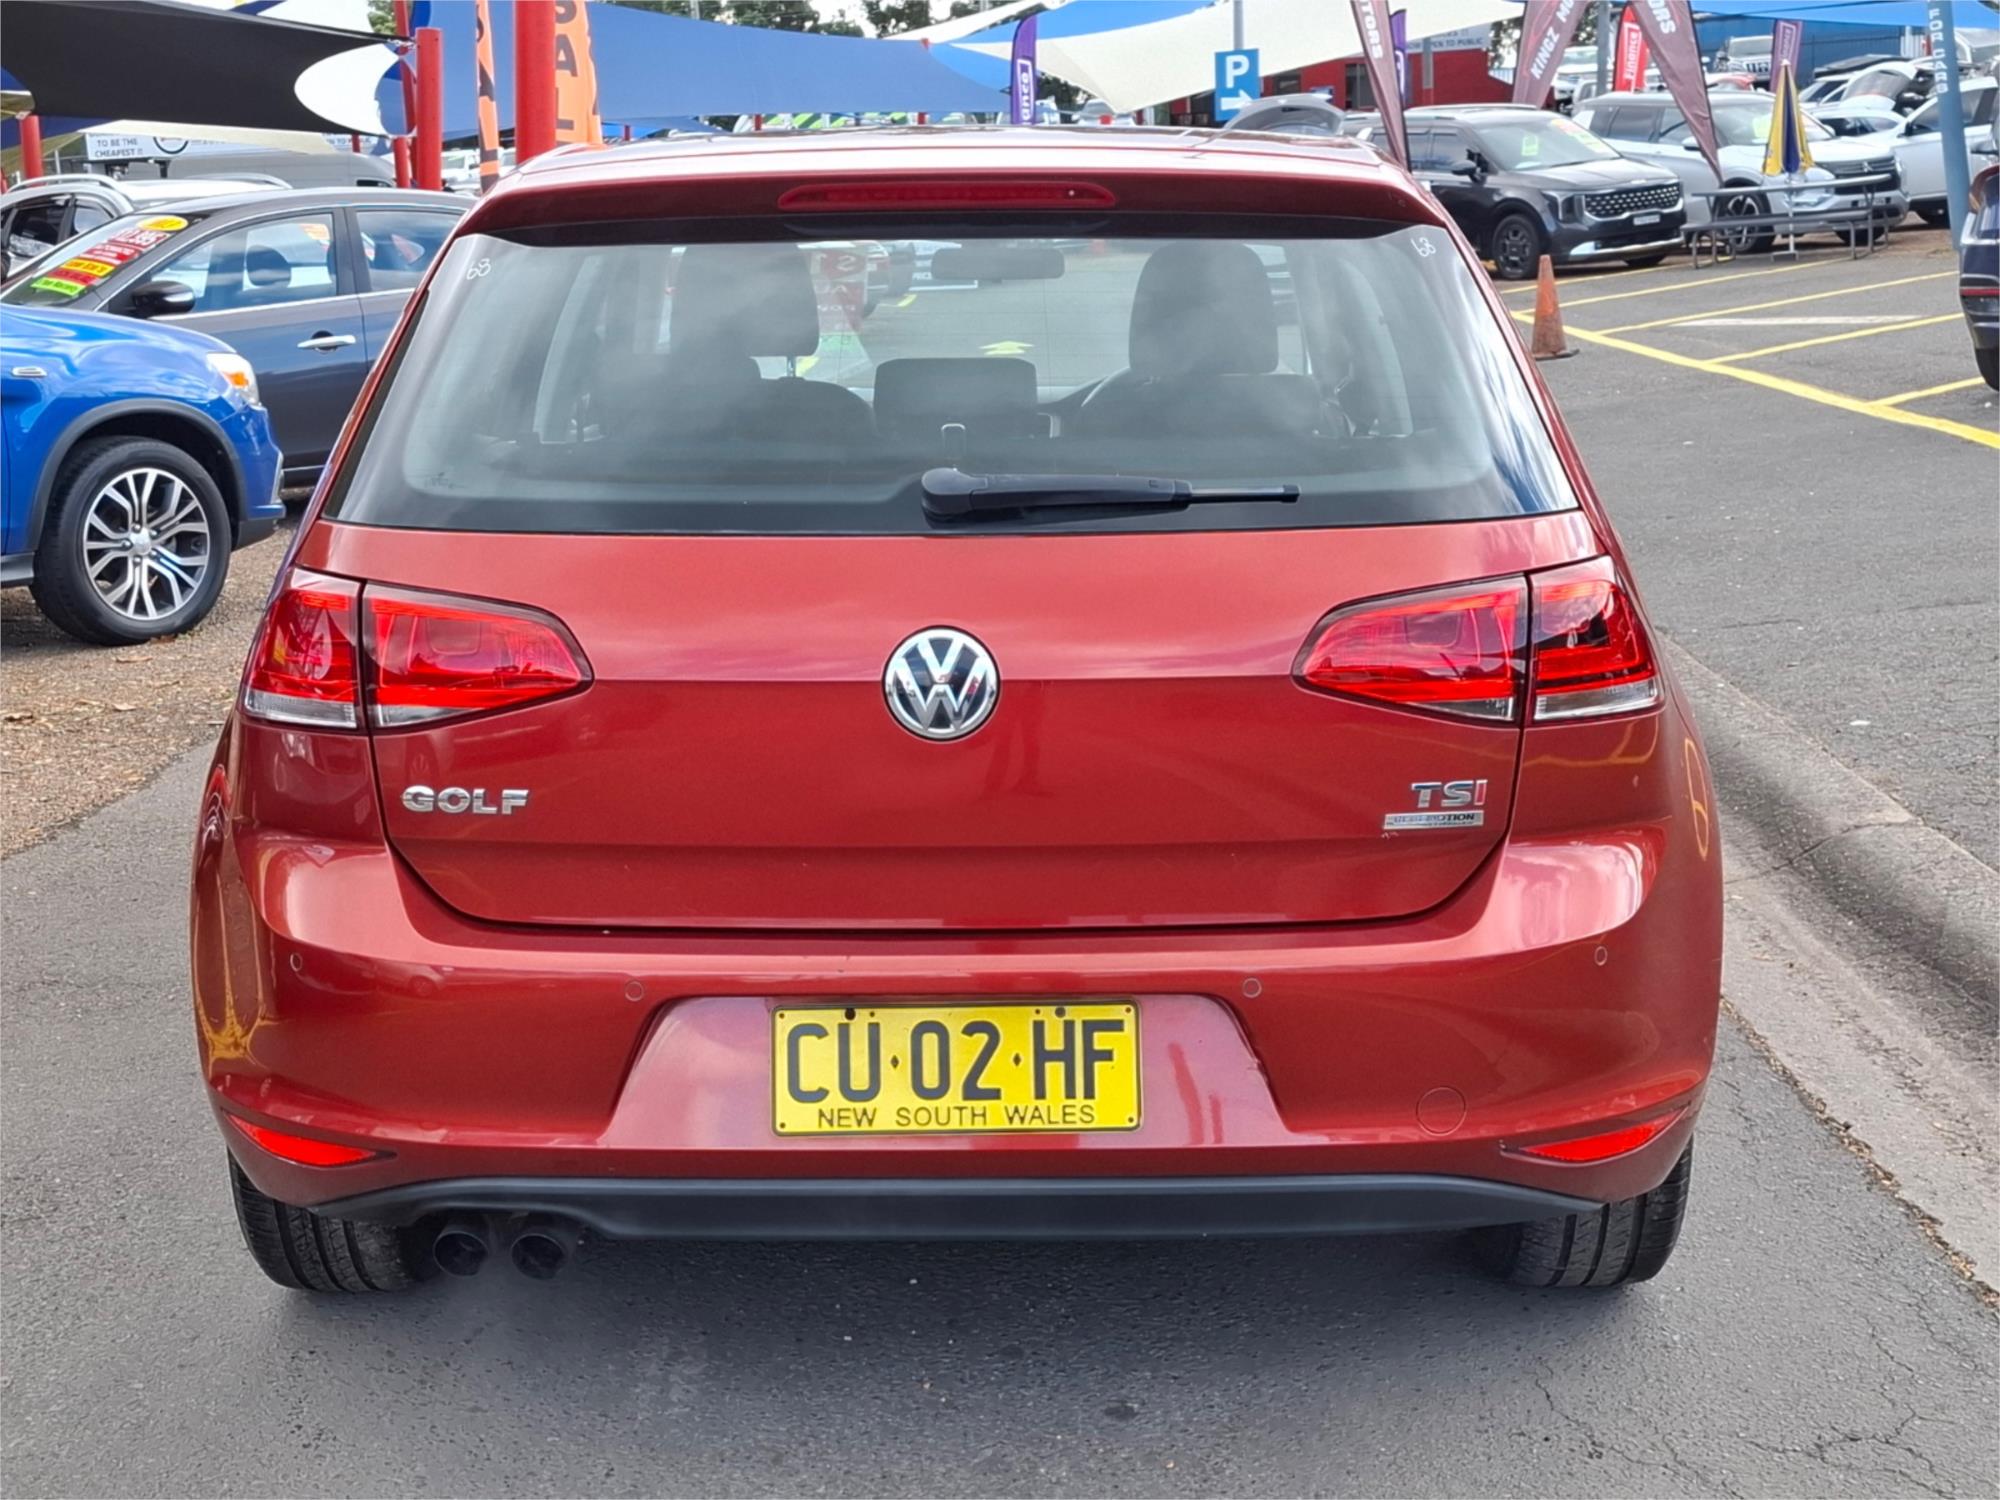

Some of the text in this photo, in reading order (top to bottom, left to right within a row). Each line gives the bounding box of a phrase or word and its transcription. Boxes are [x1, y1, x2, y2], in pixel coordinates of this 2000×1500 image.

[1530, 27, 1560, 80] KINGZ
[1624, 31, 1640, 80] Finance
[1226, 54, 1250, 89] P
[402, 785, 529, 815] GOLF
[1411, 779, 1488, 808] TSI
[818, 1104, 1095, 1128] NEW SOUTH WALES
